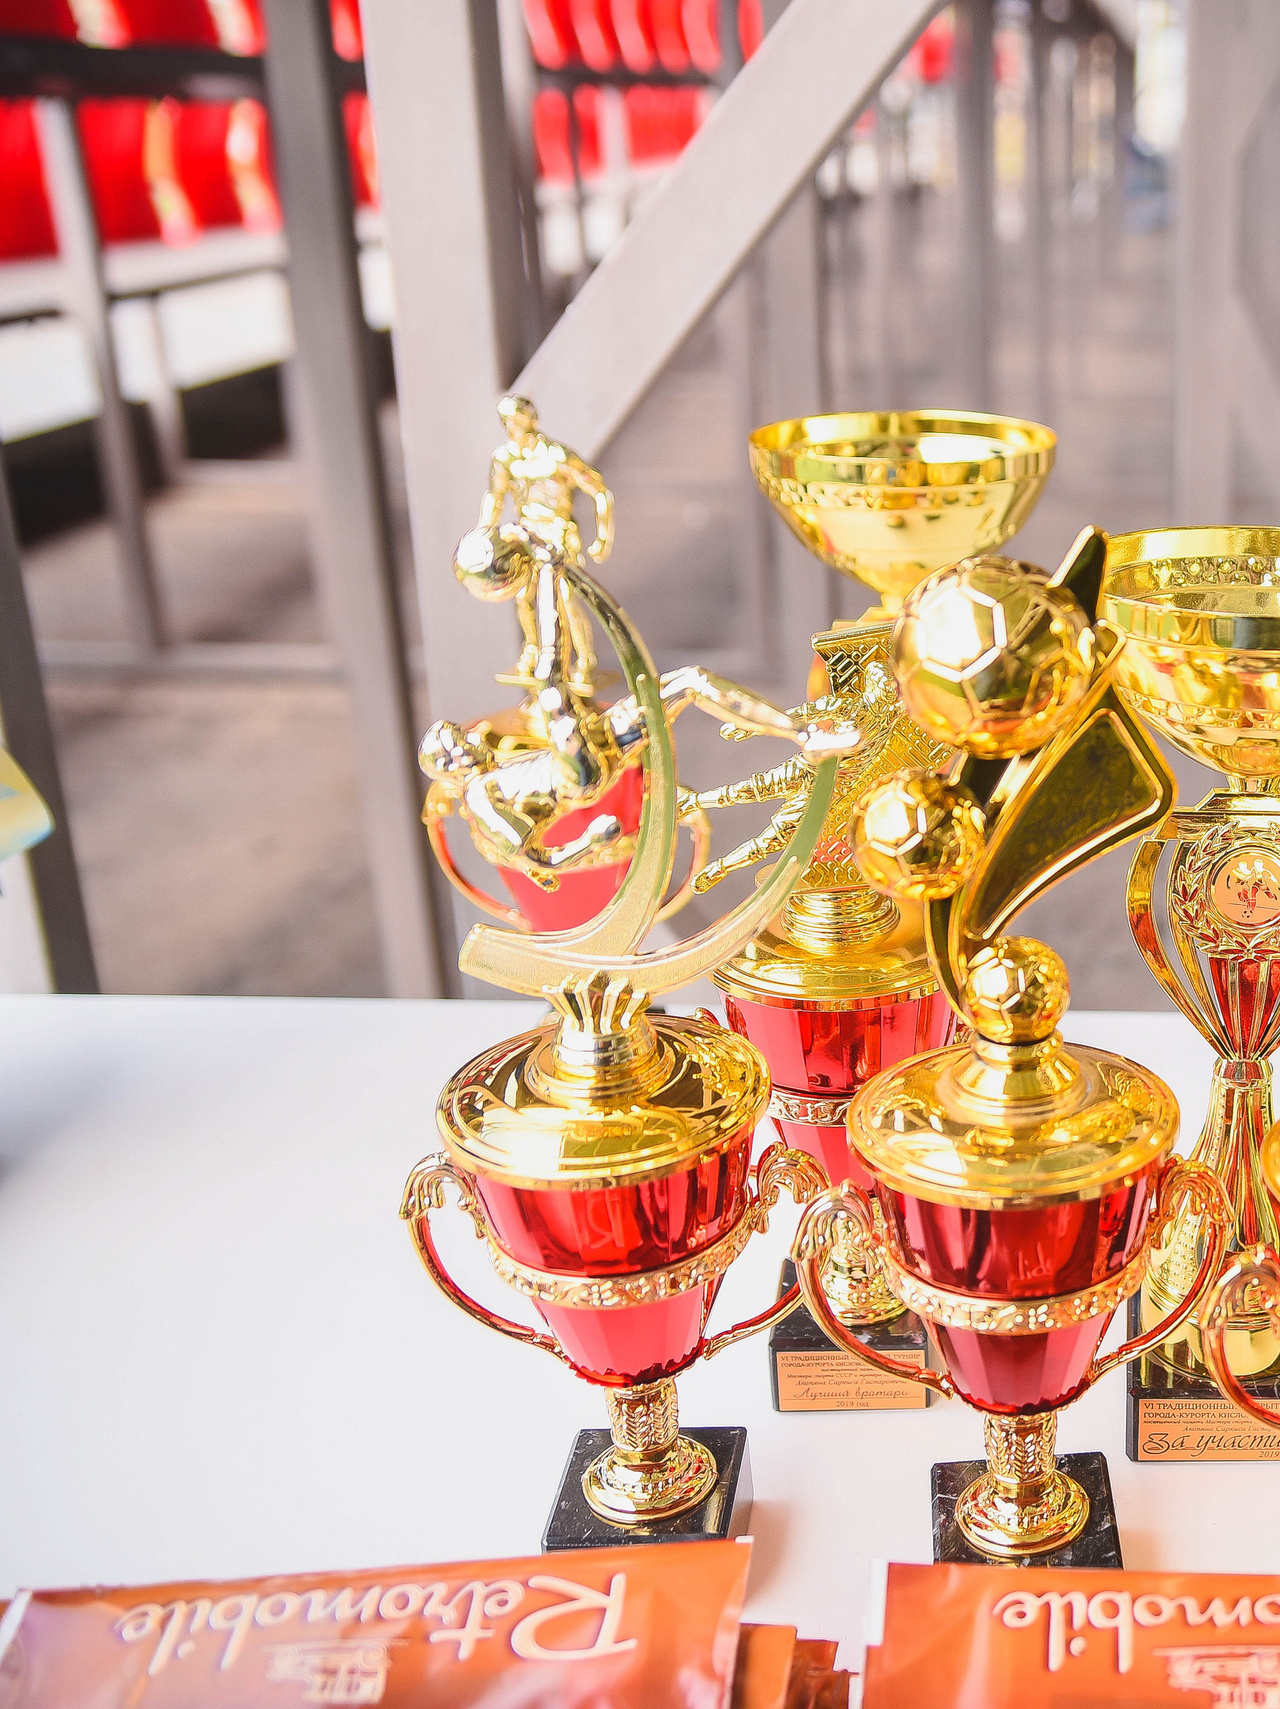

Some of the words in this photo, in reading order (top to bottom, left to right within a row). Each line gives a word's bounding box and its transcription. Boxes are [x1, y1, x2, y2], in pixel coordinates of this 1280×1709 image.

[1142, 1432, 1190, 1455] За
[1259, 1450, 1280, 1458] 2019
[116, 1573, 637, 1677] Retromobile
